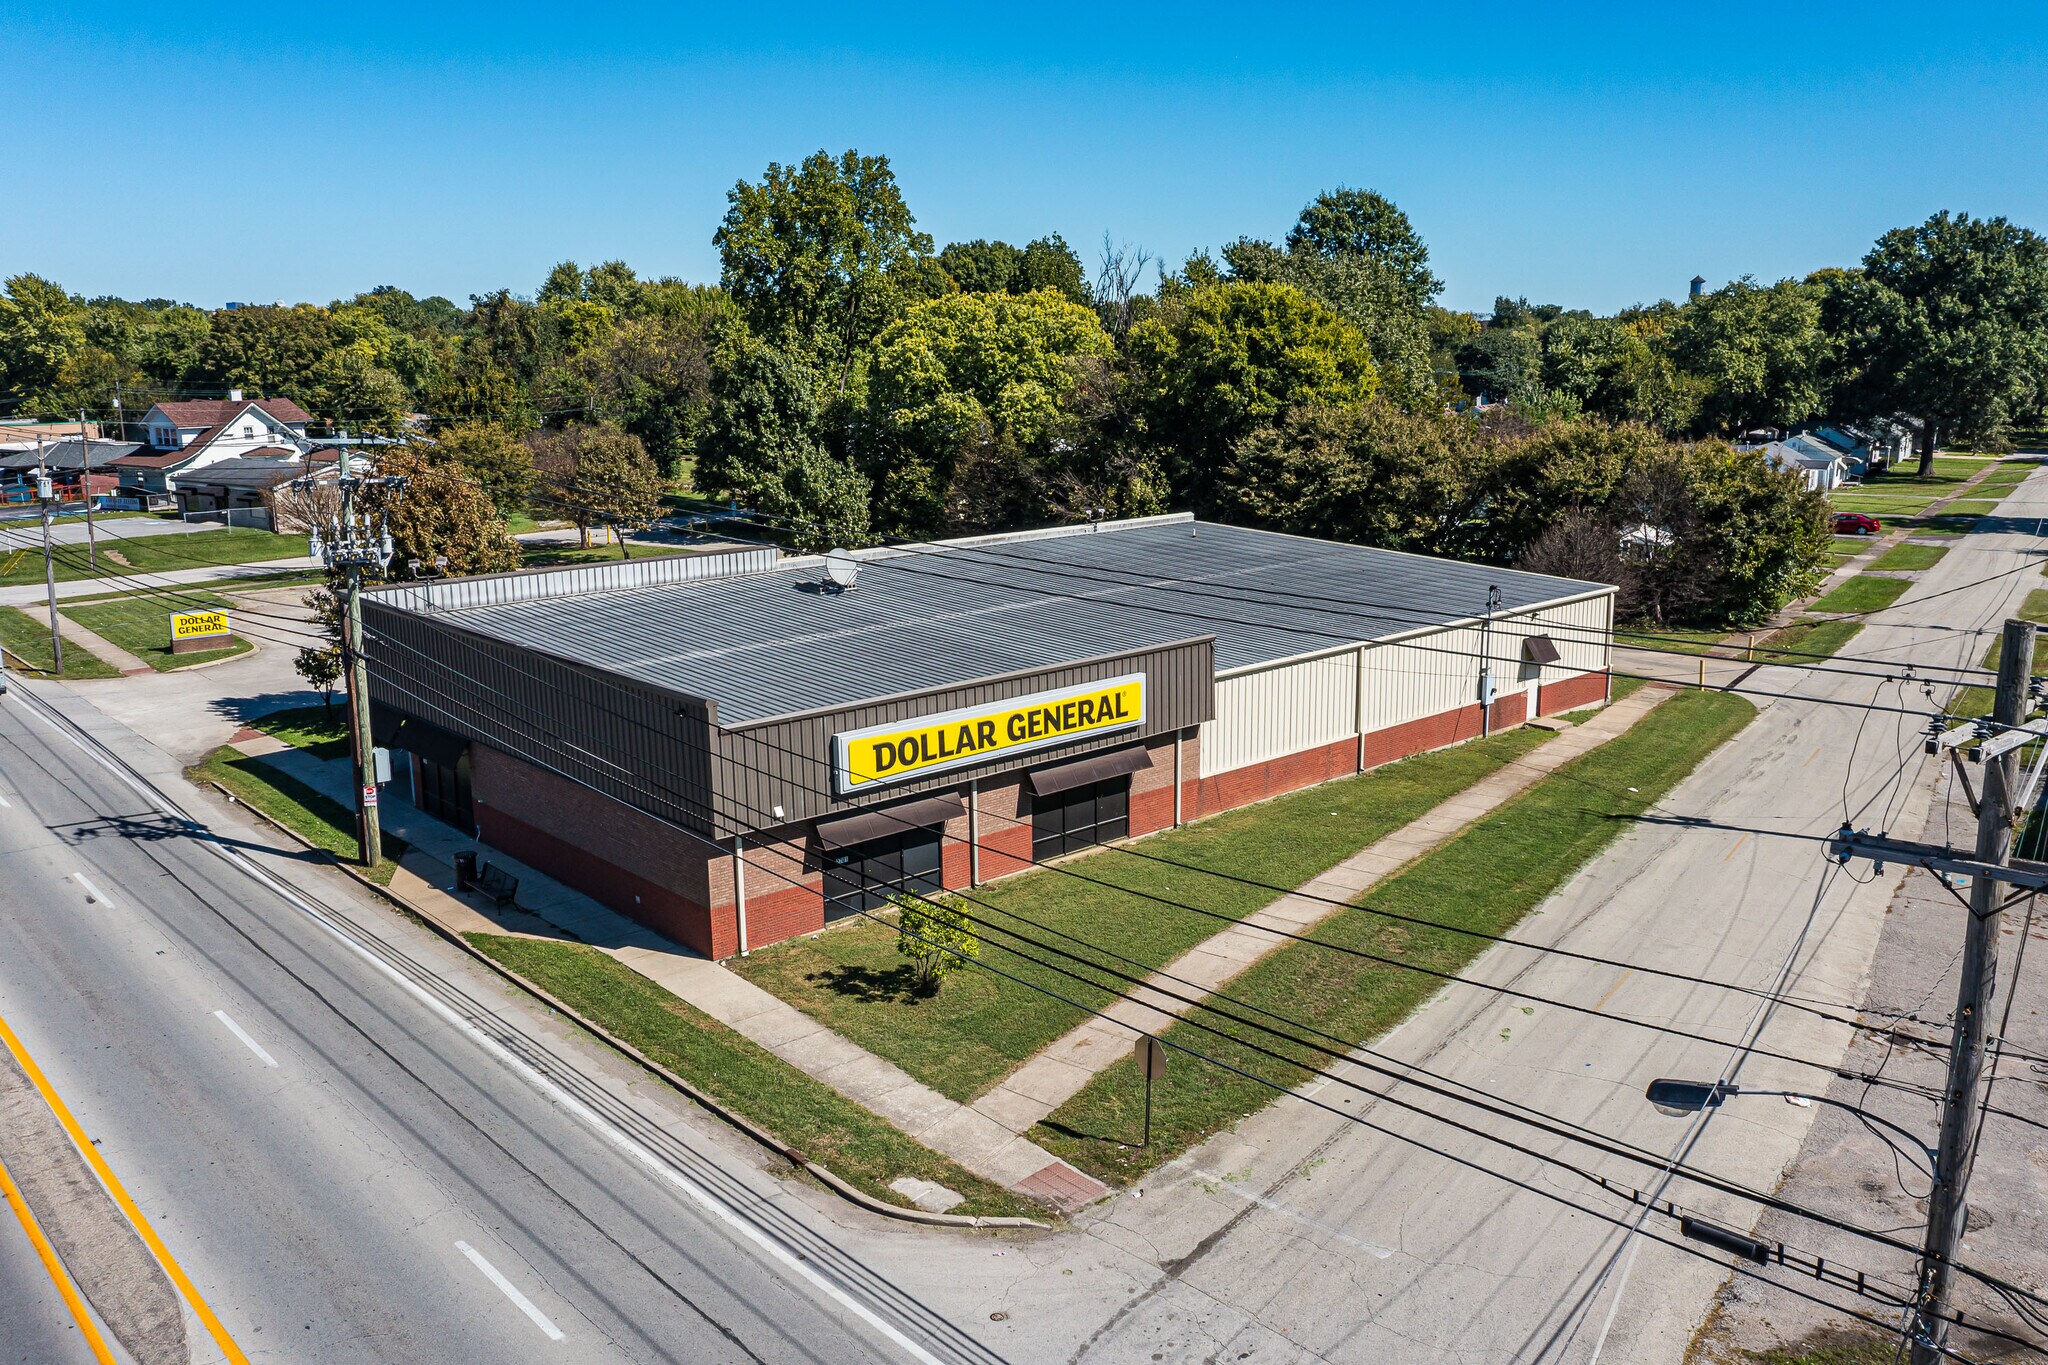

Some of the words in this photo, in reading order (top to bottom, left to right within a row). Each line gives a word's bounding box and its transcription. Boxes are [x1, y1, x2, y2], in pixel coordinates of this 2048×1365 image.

[180, 615, 221, 625] DOLLAR
[178, 624, 225, 634] GENERAL
[873, 720, 998, 773] DOLLAR
[1007, 692, 1129, 742] GENERAL
